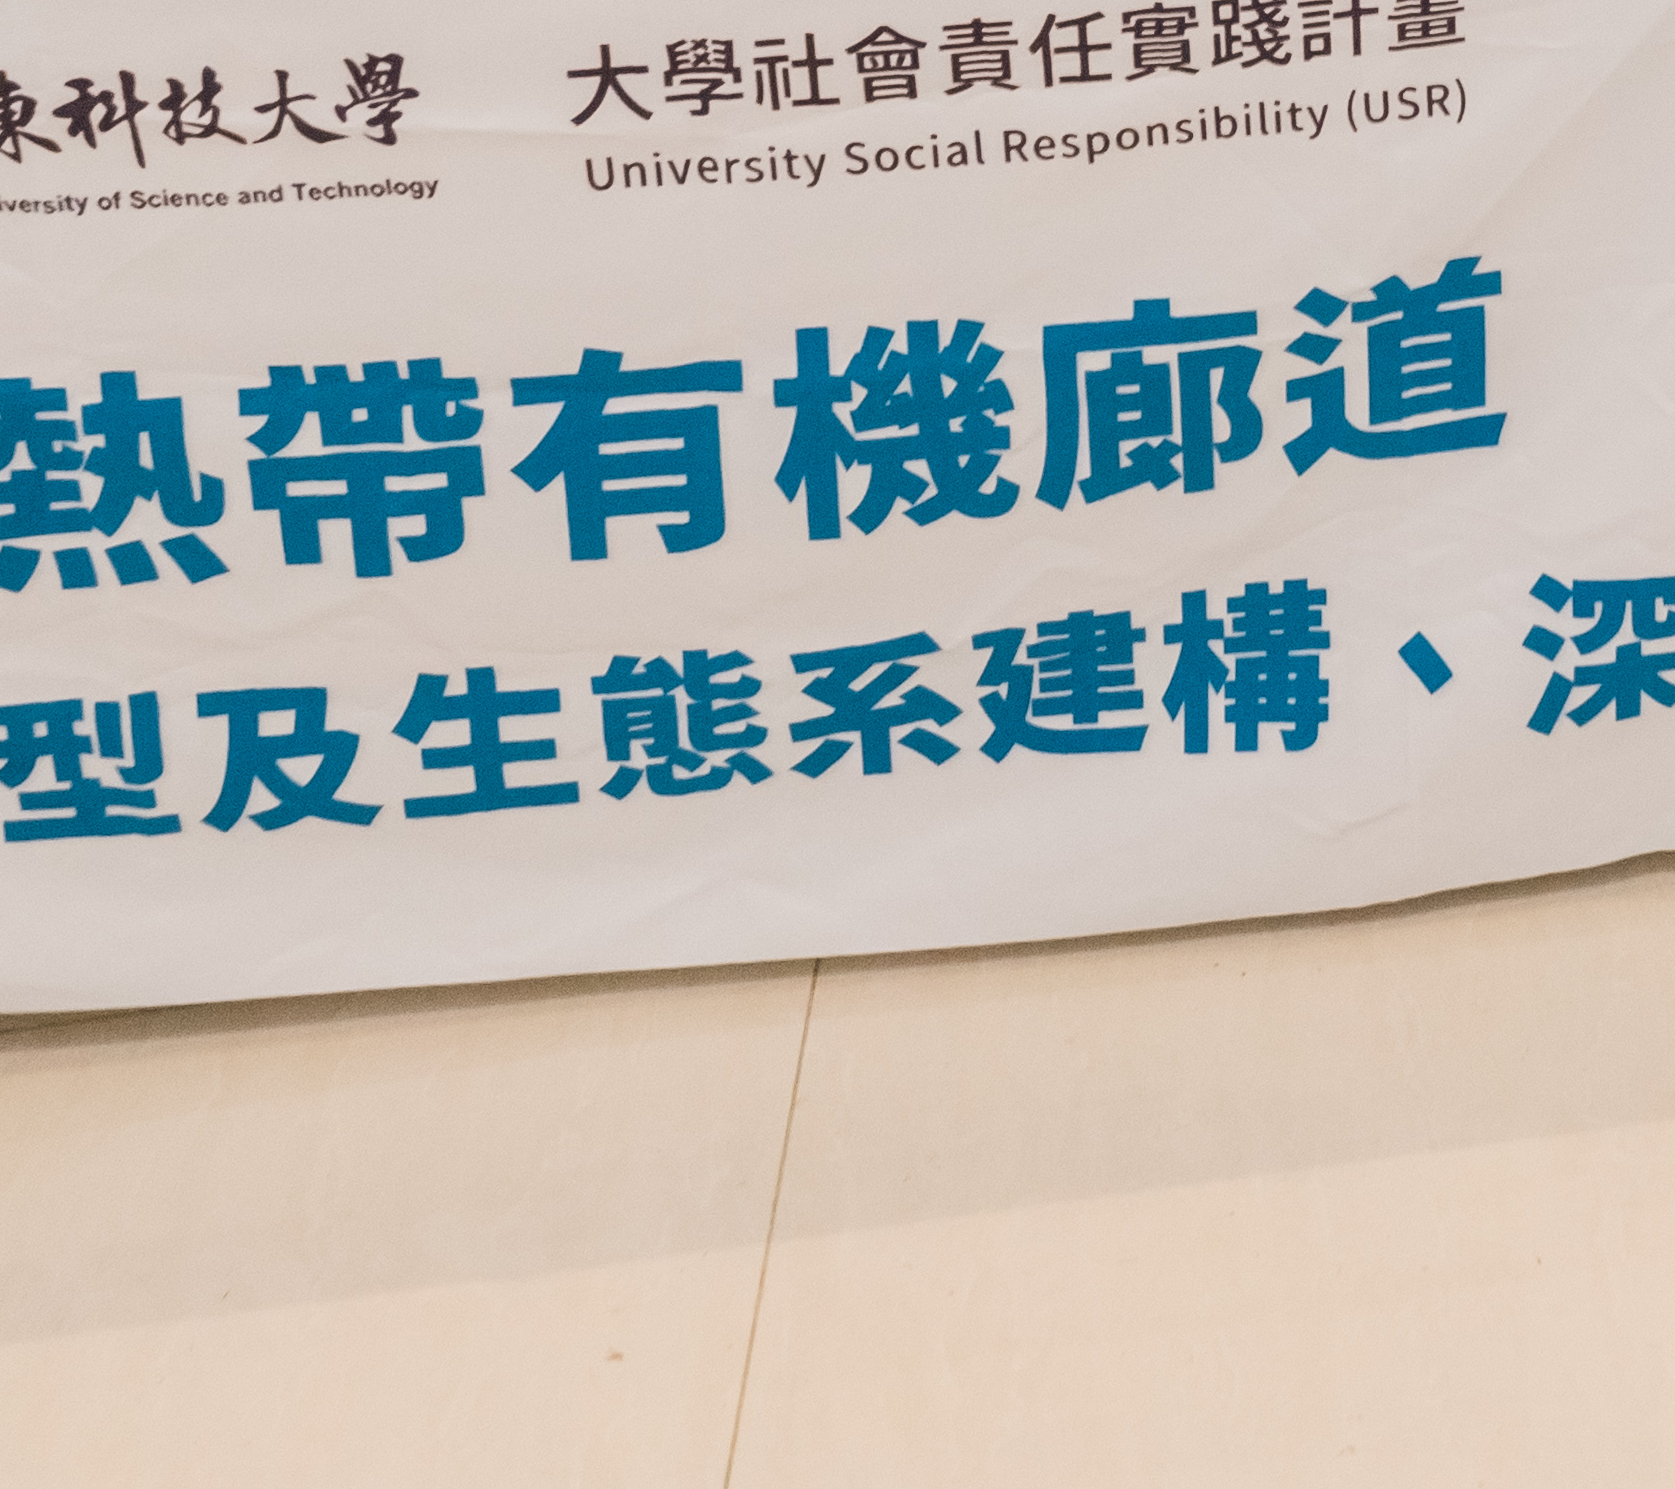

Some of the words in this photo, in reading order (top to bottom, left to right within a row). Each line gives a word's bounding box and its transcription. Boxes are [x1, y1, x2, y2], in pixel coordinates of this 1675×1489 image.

[584, 145, 827, 194] University
[844, 129, 988, 177] Social
[1002, 96, 1332, 167] Responsibility
[1344, 77, 1470, 134] (USR)
[98, 189, 123, 212] of
[129, 187, 229, 211] Science
[237, 184, 285, 205] and
[293, 176, 439, 203] Technology
